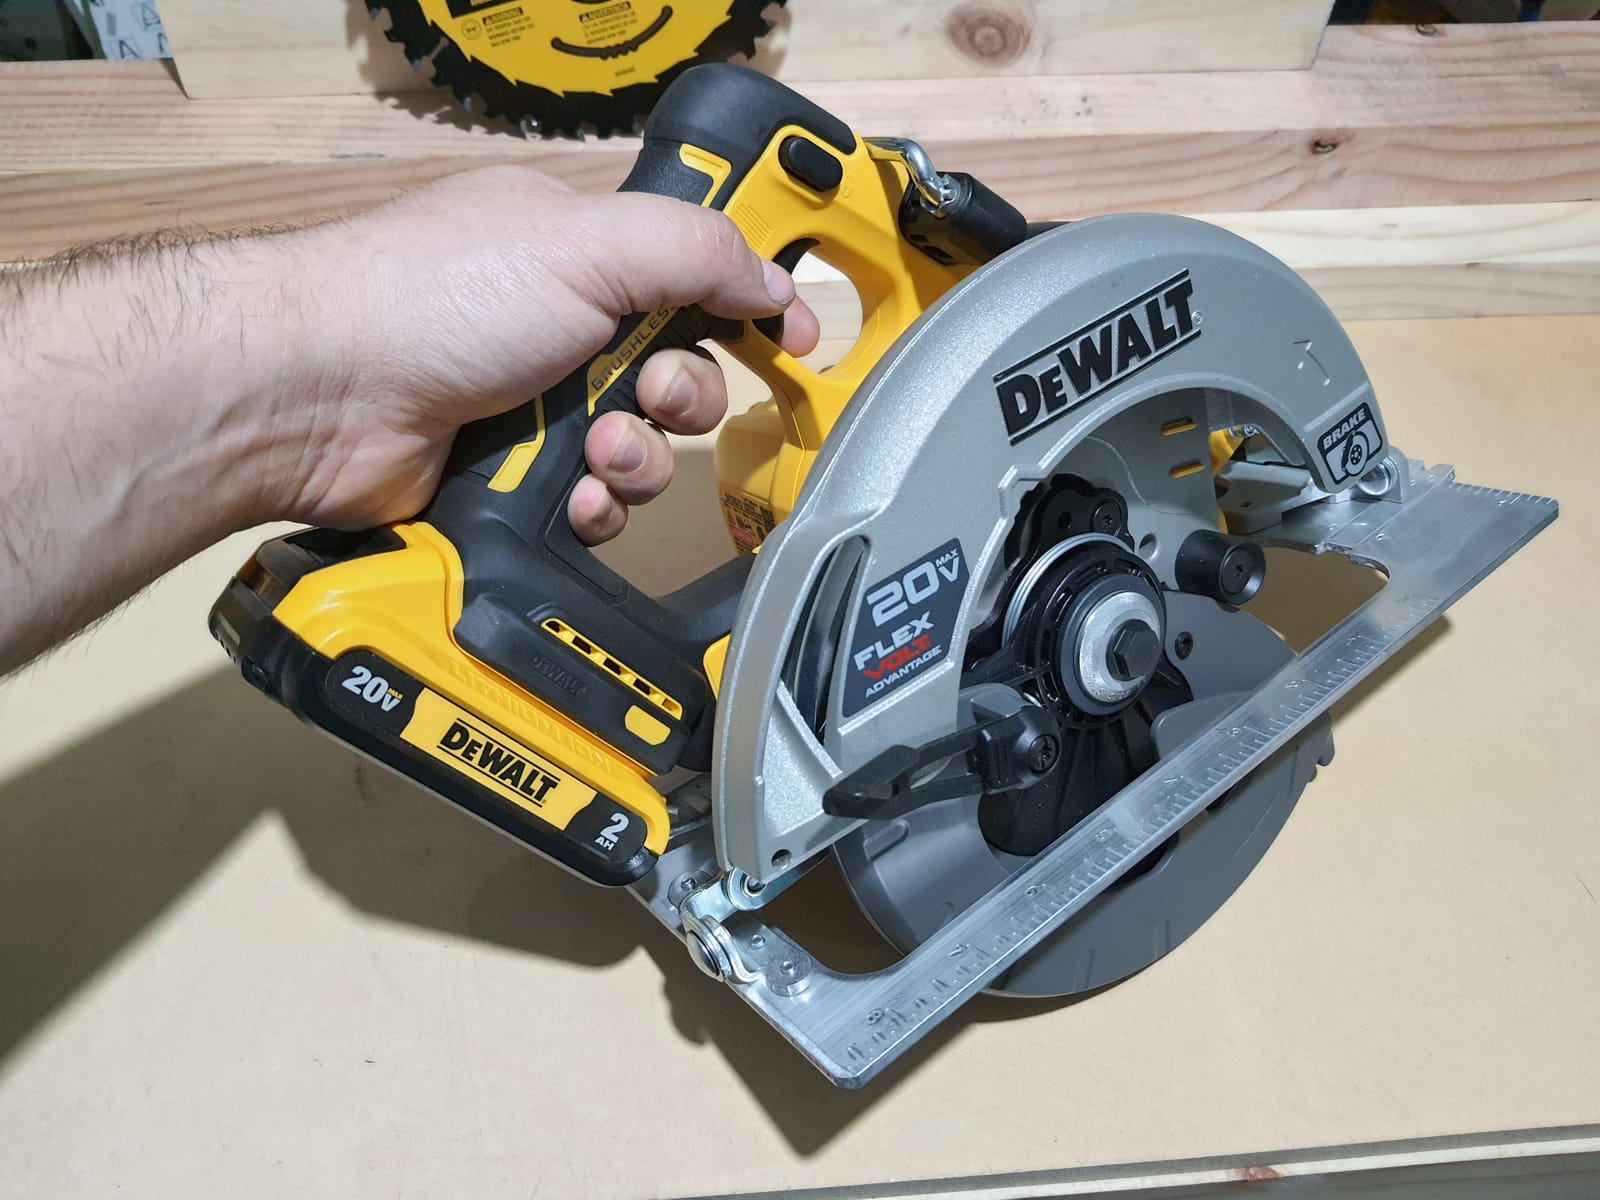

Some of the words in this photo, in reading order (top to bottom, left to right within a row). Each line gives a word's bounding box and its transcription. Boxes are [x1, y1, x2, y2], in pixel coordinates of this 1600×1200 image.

[591, 306, 676, 391] BRUSHLES
[1323, 408, 1367, 449] BRAKE
[935, 548, 959, 567] MAX
[854, 611, 934, 670] FLEX
[862, 633, 933, 679] VOLT
[865, 644, 943, 698] ADVANTAGE
[600, 812, 630, 843] 2
